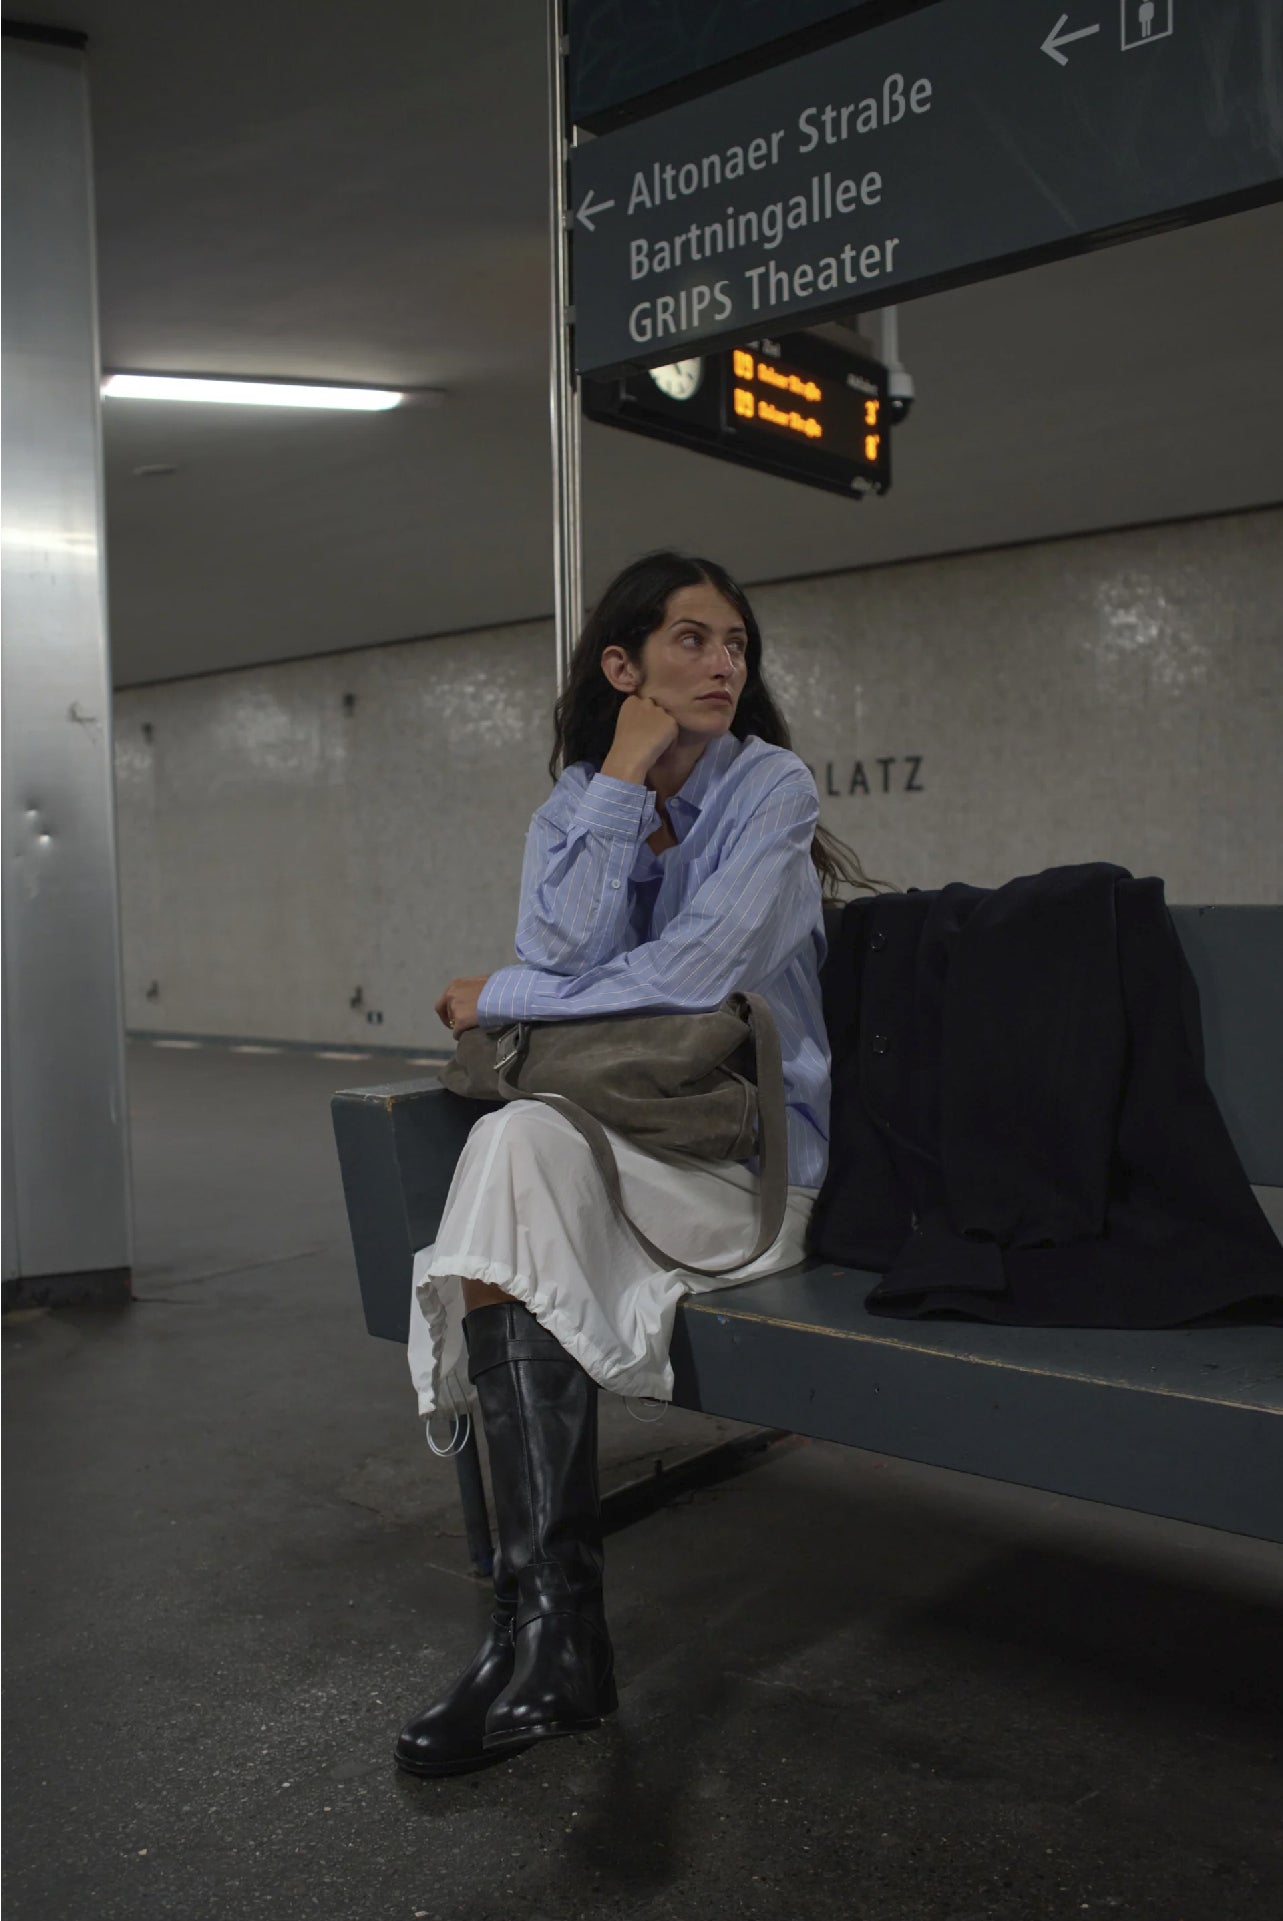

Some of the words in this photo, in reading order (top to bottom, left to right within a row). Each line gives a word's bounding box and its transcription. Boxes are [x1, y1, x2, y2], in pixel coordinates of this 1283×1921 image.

[626, 129, 785, 215] Altonaer
[798, 72, 933, 153] Straße
[629, 170, 883, 280] Bartningallee
[628, 280, 733, 343] GRIPS
[744, 237, 900, 310] Theater
